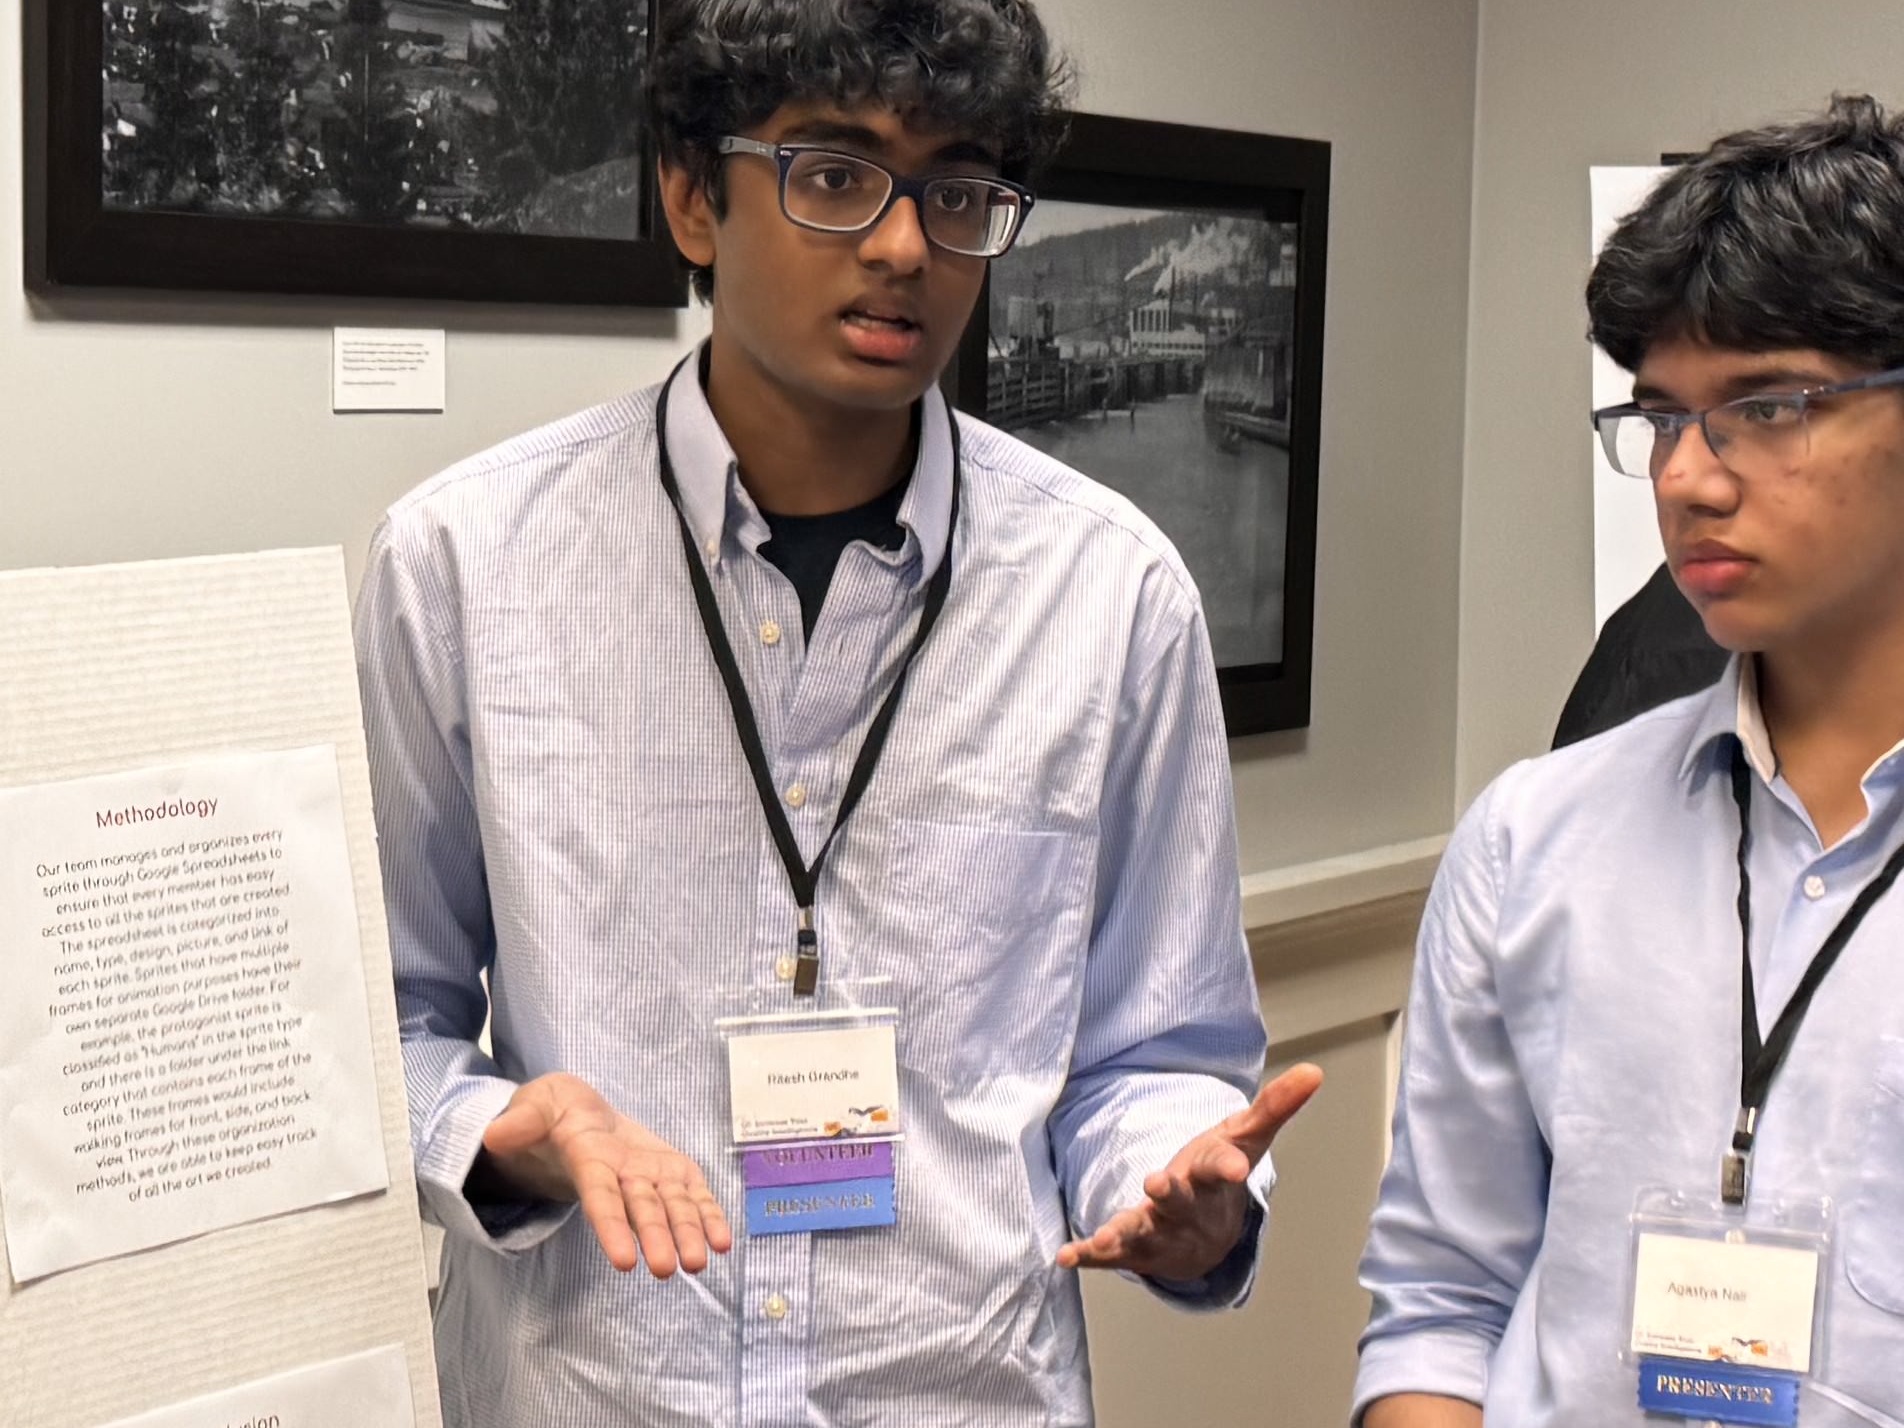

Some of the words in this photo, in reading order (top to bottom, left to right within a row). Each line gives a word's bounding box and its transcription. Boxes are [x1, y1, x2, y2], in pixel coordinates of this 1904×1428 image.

[95, 797, 218, 829] Methodology
[35, 863, 61, 879] Our
[63, 858, 98, 874] team
[160, 840, 186, 858] and
[187, 834, 250, 855] organizes
[251, 829, 283, 844] every
[42, 880, 80, 899] sprite
[81, 869, 135, 892] through
[136, 864, 180, 882] Google
[181, 849, 268, 876] Spreadsheets
[268, 846, 283, 860] to
[763, 1143, 874, 1166] VOLUNTEER
[764, 1193, 875, 1218] PRESENTER
[1667, 1281, 1718, 1302] Agastya
[1656, 1374, 1774, 1405] PRESENTER
